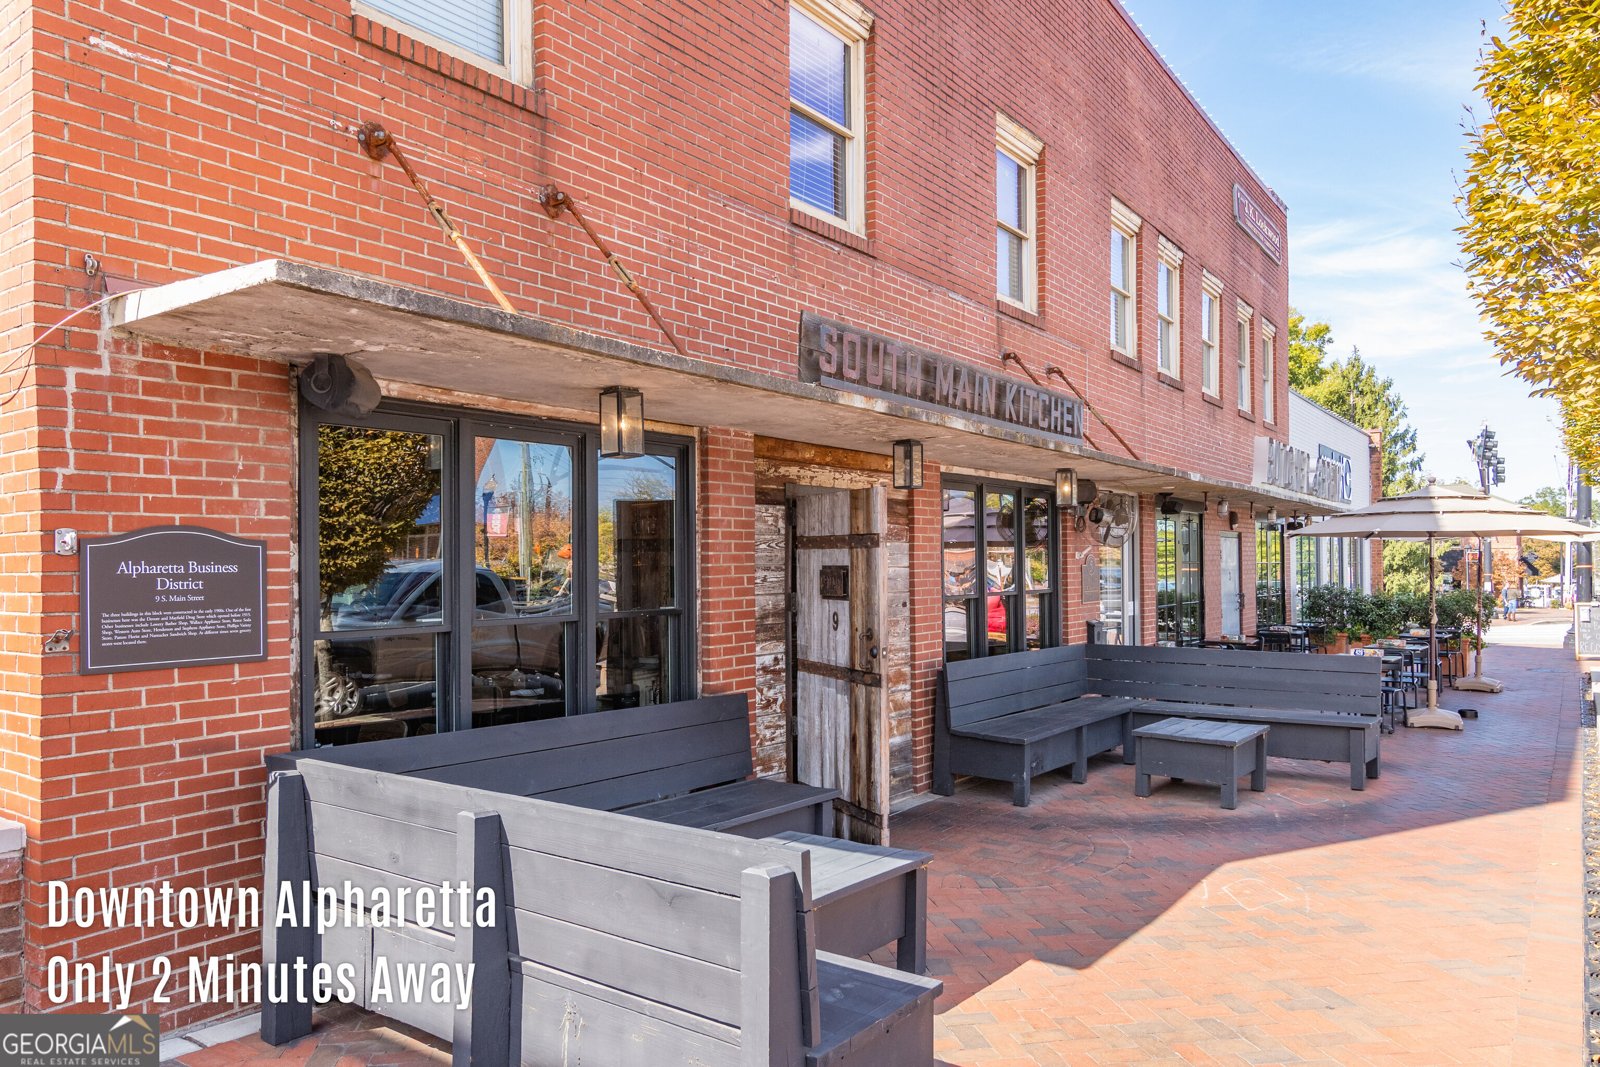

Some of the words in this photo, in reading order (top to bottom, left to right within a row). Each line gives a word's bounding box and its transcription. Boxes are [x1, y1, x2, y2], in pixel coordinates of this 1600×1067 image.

[818, 324, 922, 397] SOUTH
[936, 360, 997, 415] MAIN
[1005, 382, 1084, 437] KITCHEN
[116, 560, 185, 578] Alpharetta
[188, 560, 238, 574] Business
[156, 578, 204, 591] District
[832, 611, 839, 631] 9
